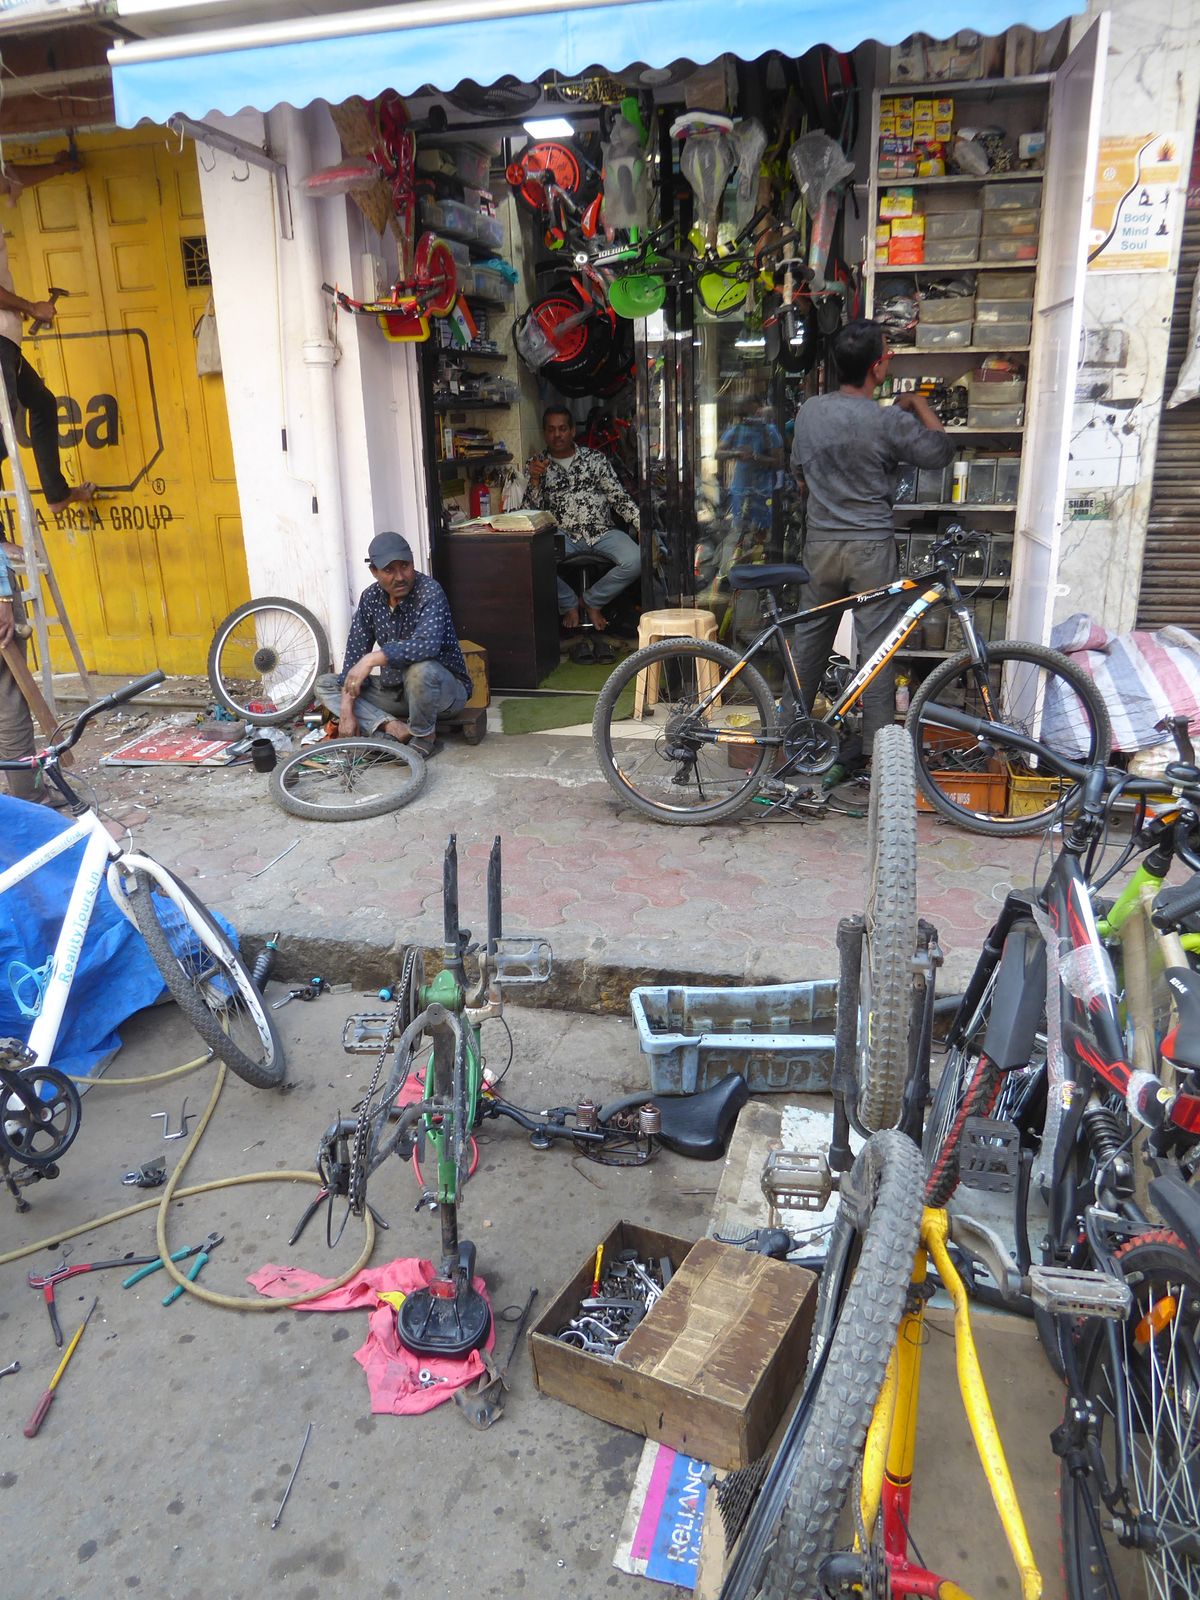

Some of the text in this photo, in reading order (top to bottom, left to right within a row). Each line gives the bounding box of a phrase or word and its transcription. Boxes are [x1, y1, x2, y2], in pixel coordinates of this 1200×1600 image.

[1124, 213, 1153, 223] Body
[1122, 227, 1149, 237] Mind
[1121, 241, 1148, 251] Soul
[1069, 500, 1094, 508] SHARE
[110, 505, 173, 531] GROUP
[1169, 977, 1188, 994] ATLAS
